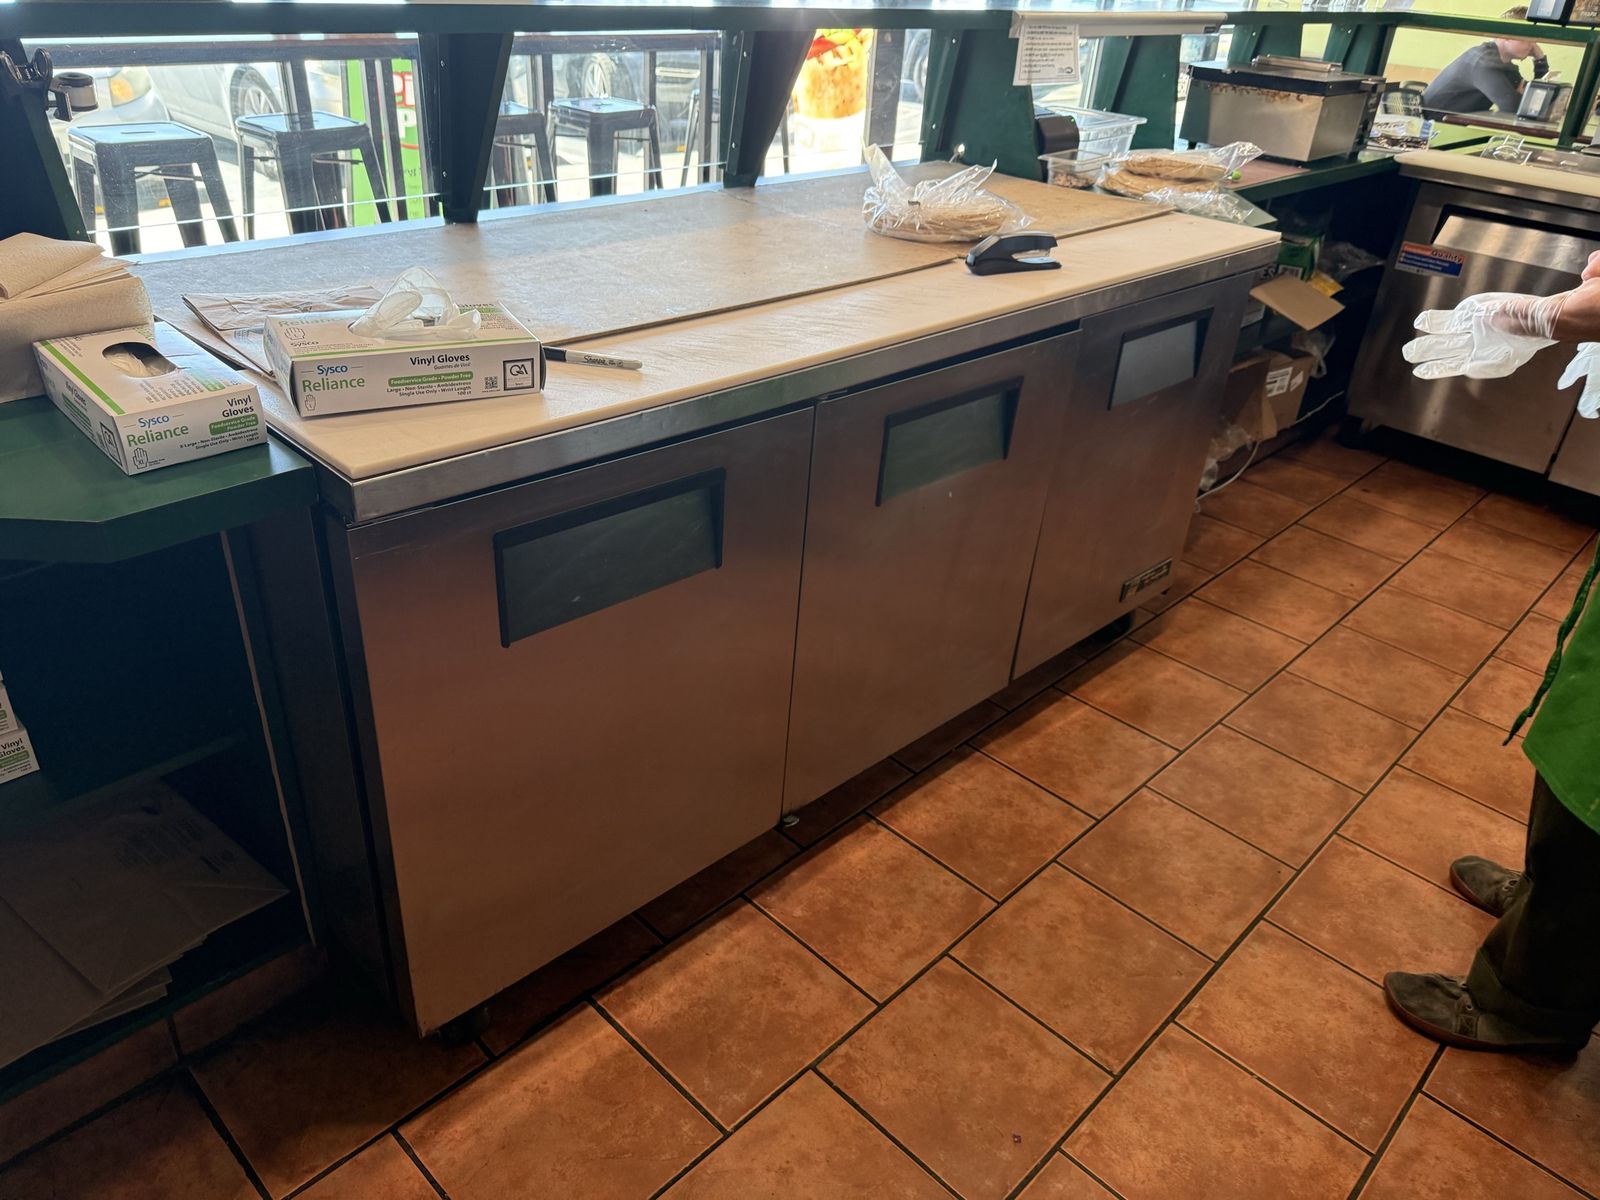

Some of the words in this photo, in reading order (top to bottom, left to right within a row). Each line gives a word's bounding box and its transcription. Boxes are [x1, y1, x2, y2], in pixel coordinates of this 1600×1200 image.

[410, 355, 435, 366] Vinyl
[437, 354, 470, 364] Gloves
[317, 364, 348, 376] Sysco
[302, 377, 365, 393] Reliance
[227, 395, 252, 407] Vinyl
[222, 406, 255, 418] Gloves
[138, 415, 170, 429] Sysco
[126, 425, 189, 447] Reliance
[1, 737, 23, 750] Vinyl
